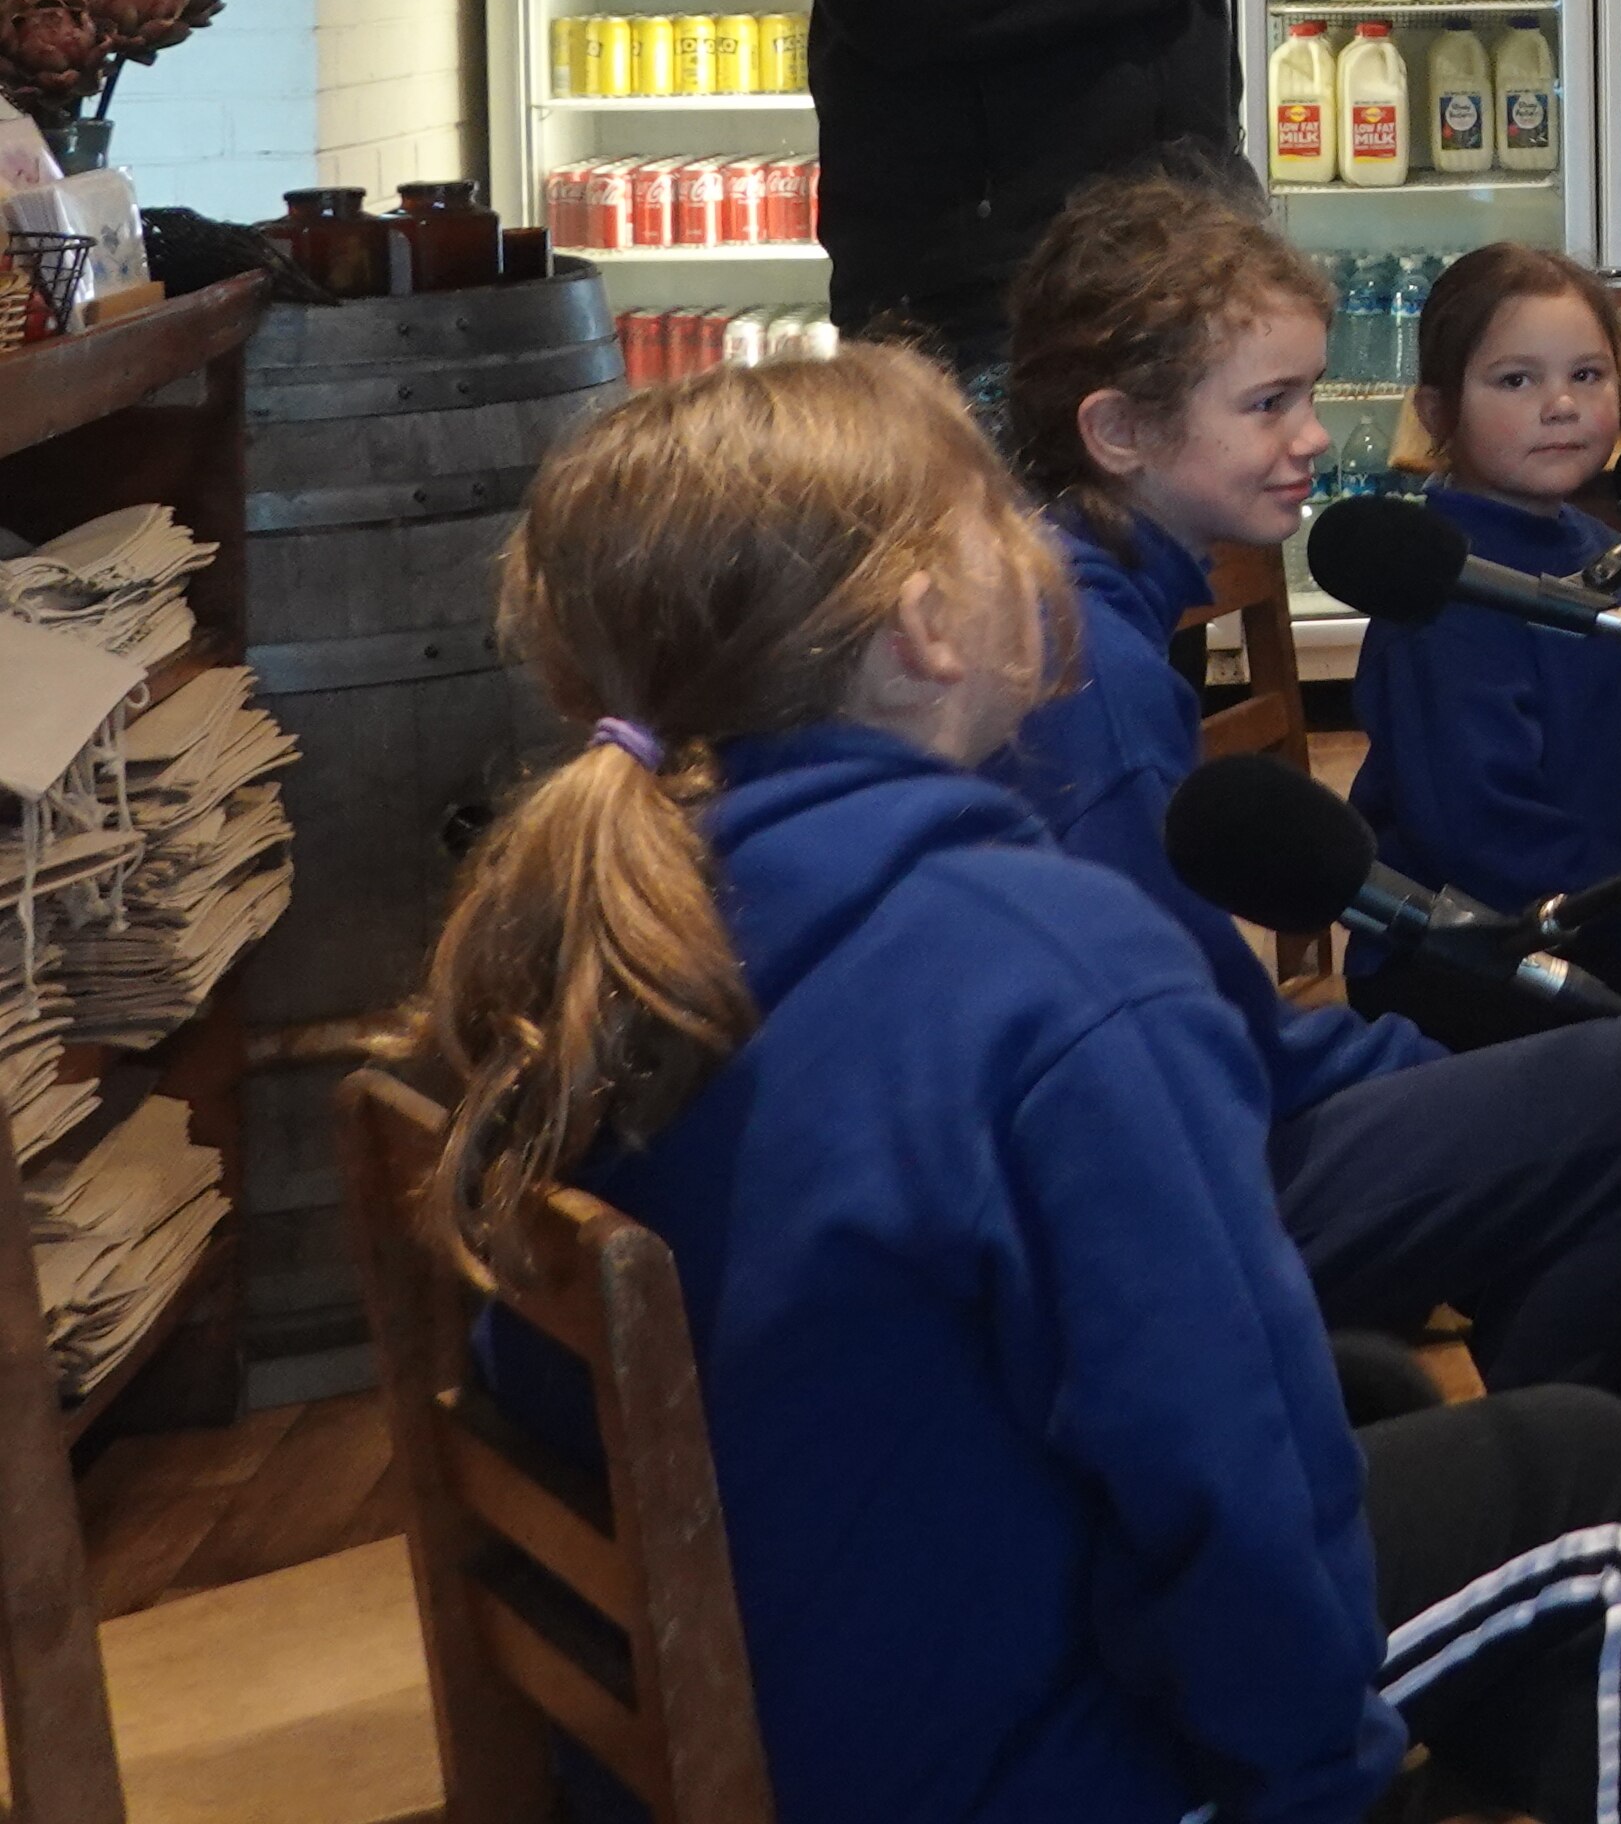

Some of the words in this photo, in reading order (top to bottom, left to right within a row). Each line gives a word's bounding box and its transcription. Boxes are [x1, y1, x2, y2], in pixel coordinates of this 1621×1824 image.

[1280, 122, 1299, 132] LOW
[1354, 123, 1374, 133] LOW
[1280, 131, 1320, 143] MILK
[1354, 132, 1396, 145] MILK
